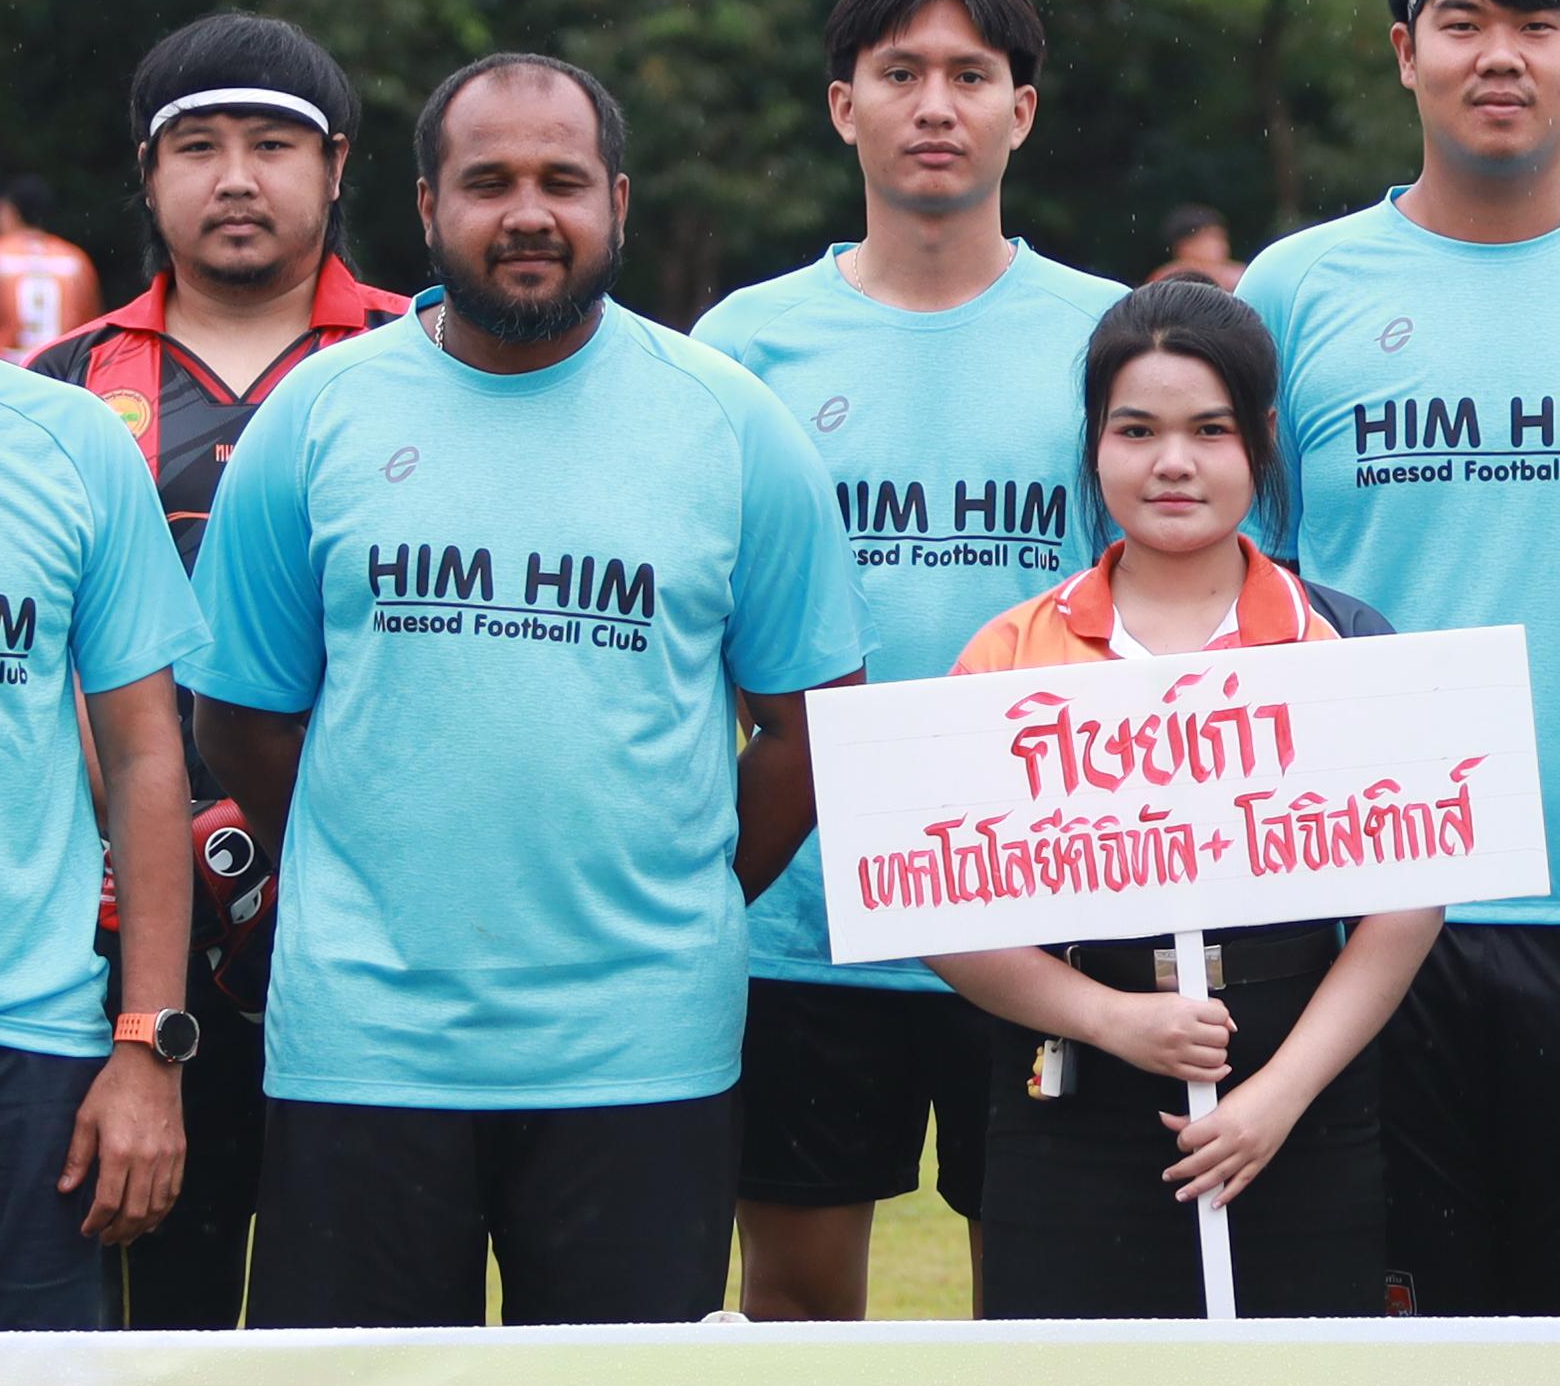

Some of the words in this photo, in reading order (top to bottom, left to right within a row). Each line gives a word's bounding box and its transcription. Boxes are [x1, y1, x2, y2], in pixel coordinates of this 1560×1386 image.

[1354, 398, 1481, 455] HIM
[1356, 459, 1453, 488] Maesod
[954, 480, 1067, 539] HIM
[369, 543, 493, 602] HIM
[525, 552, 655, 619] HIM
[852, 544, 900, 566] sod
[912, 544, 1008, 567] Football
[1018, 546, 1060, 572] Club
[373, 611, 462, 634] Maesod
[474, 614, 580, 644] Football
[591, 624, 648, 652] Club
[1005, 667, 1294, 801] ศิษย์เก่า
